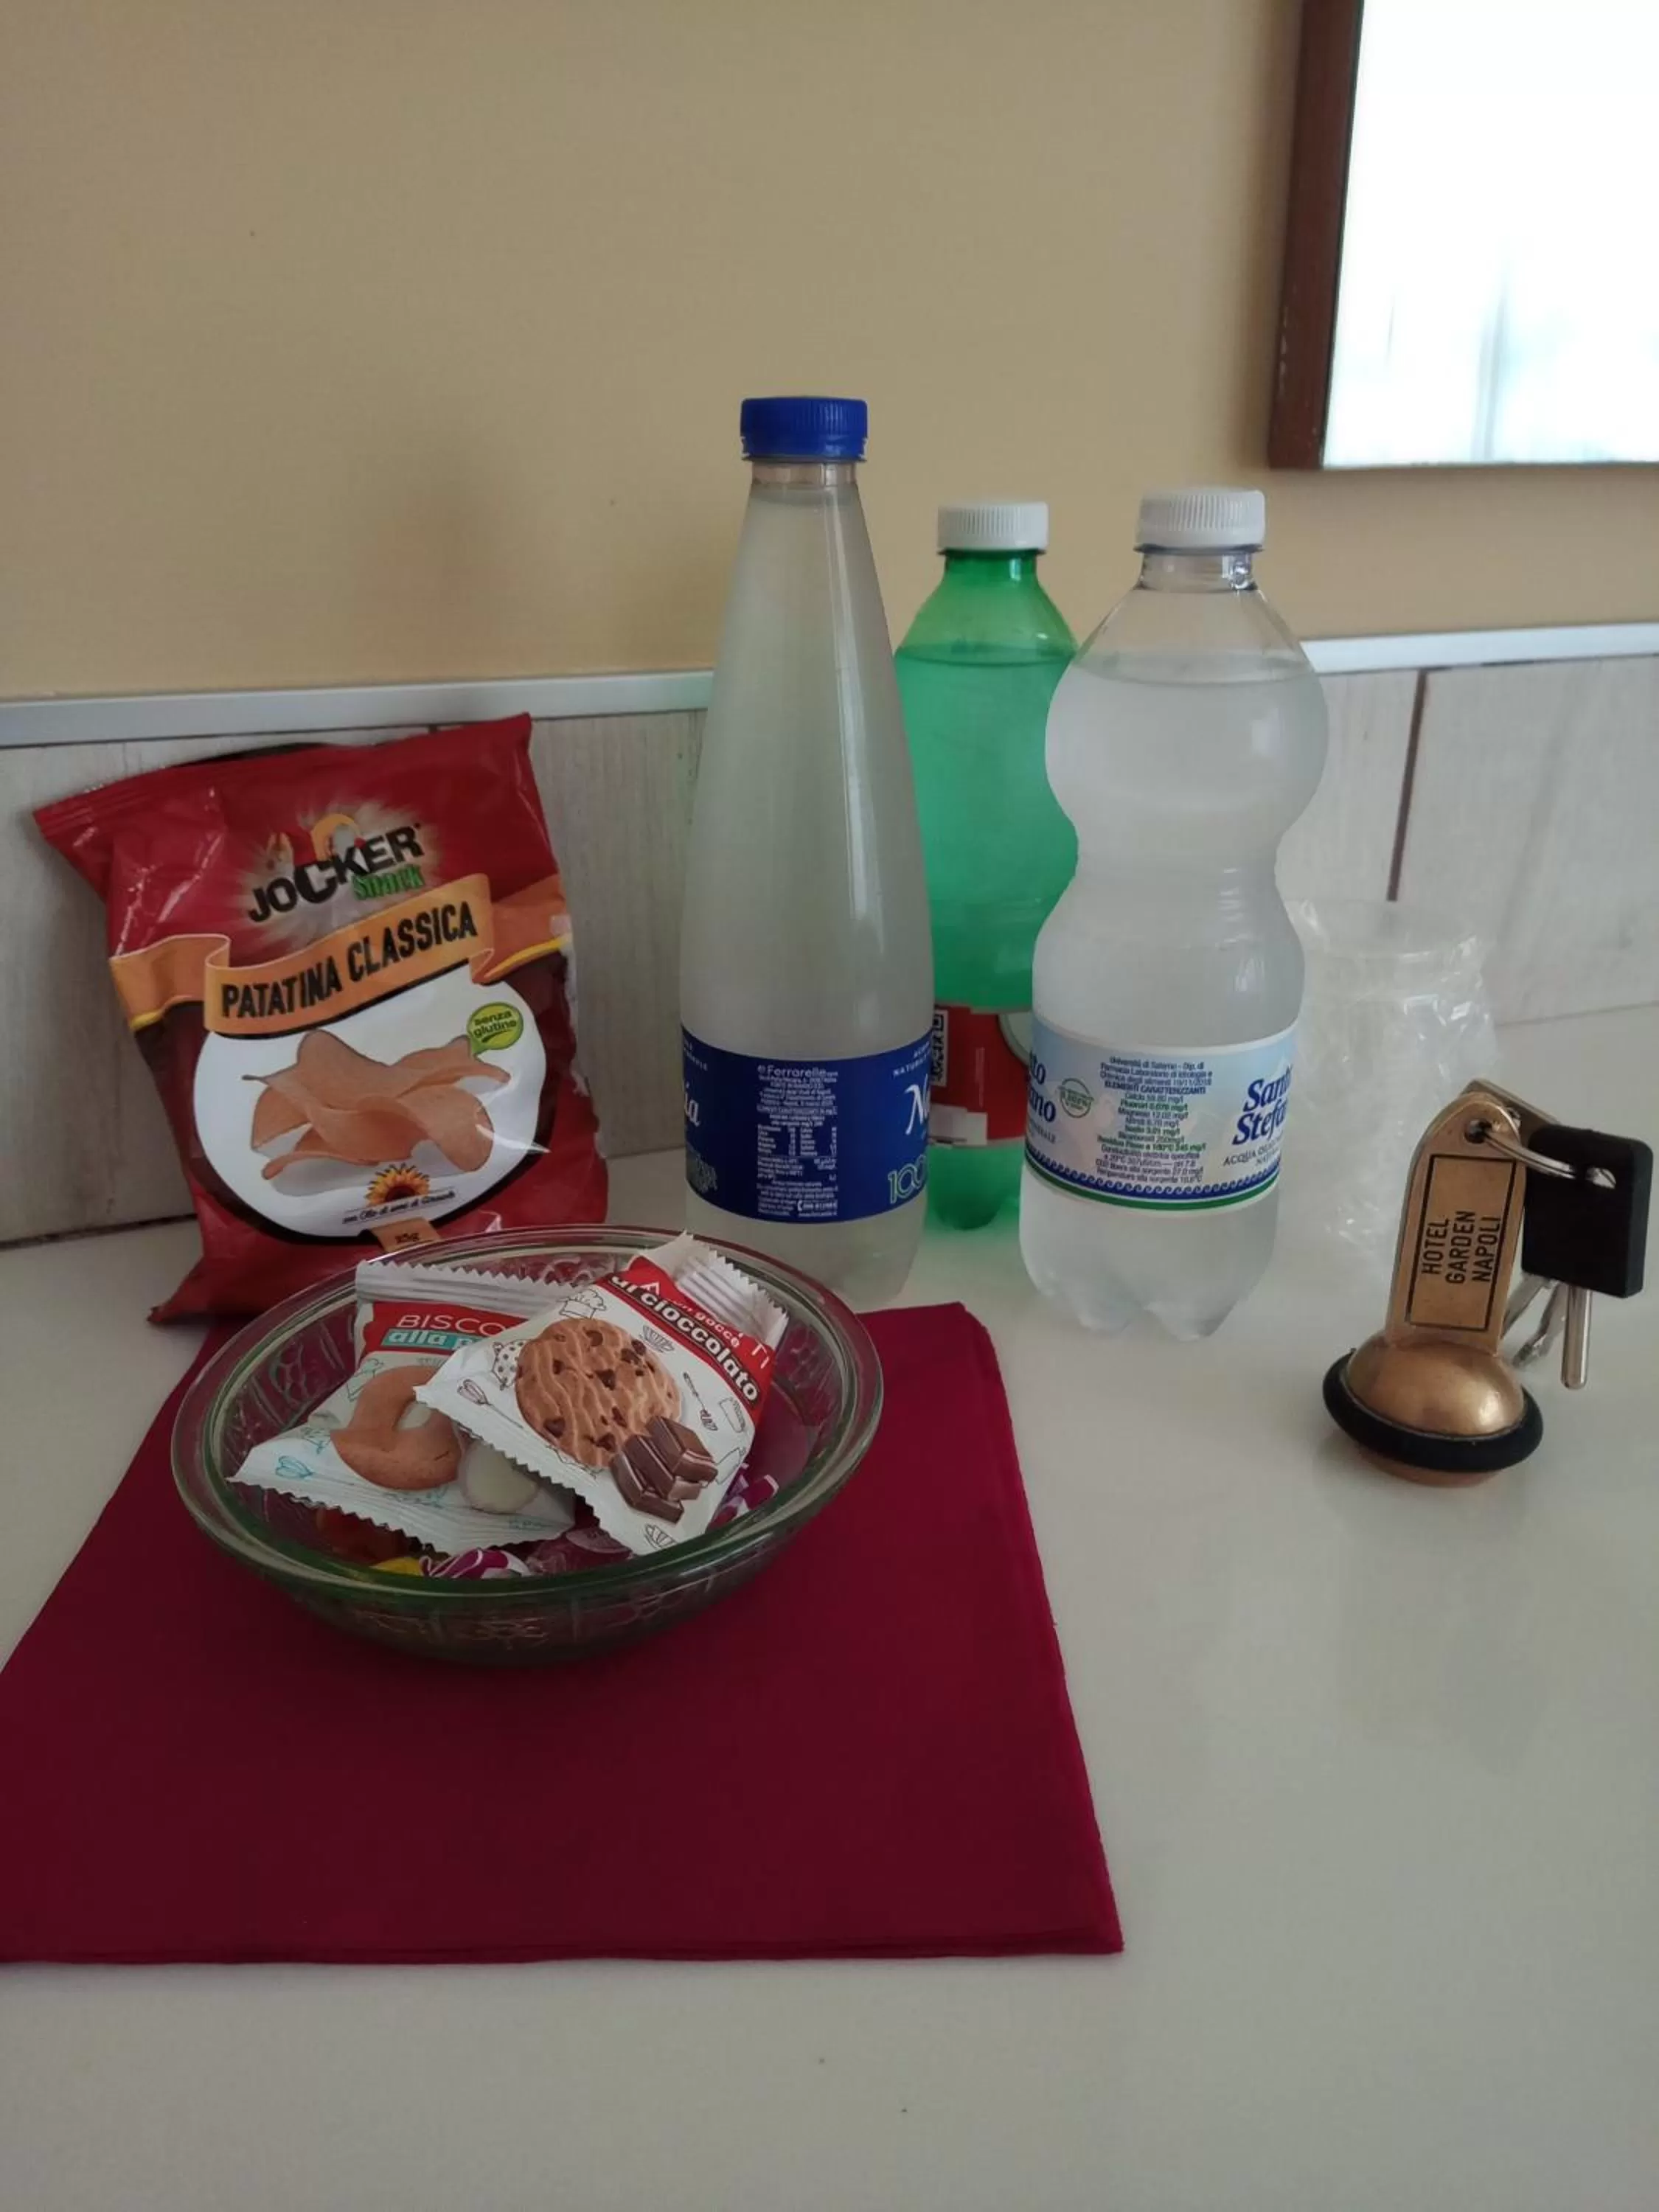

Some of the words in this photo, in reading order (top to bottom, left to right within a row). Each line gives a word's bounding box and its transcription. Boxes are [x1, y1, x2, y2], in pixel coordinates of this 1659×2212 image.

[248, 825, 425, 922] JOCKER
[223, 956, 342, 1018] PATATINA
[347, 901, 478, 982] CLASSICA
[1422, 1218, 1450, 1274] HOTEL
[1445, 1211, 1476, 1284] GARDEN
[1472, 1217, 1501, 1282] NAPOLI
[388, 1329, 447, 1346] alla
[640, 1290, 759, 1401] cioccolato
